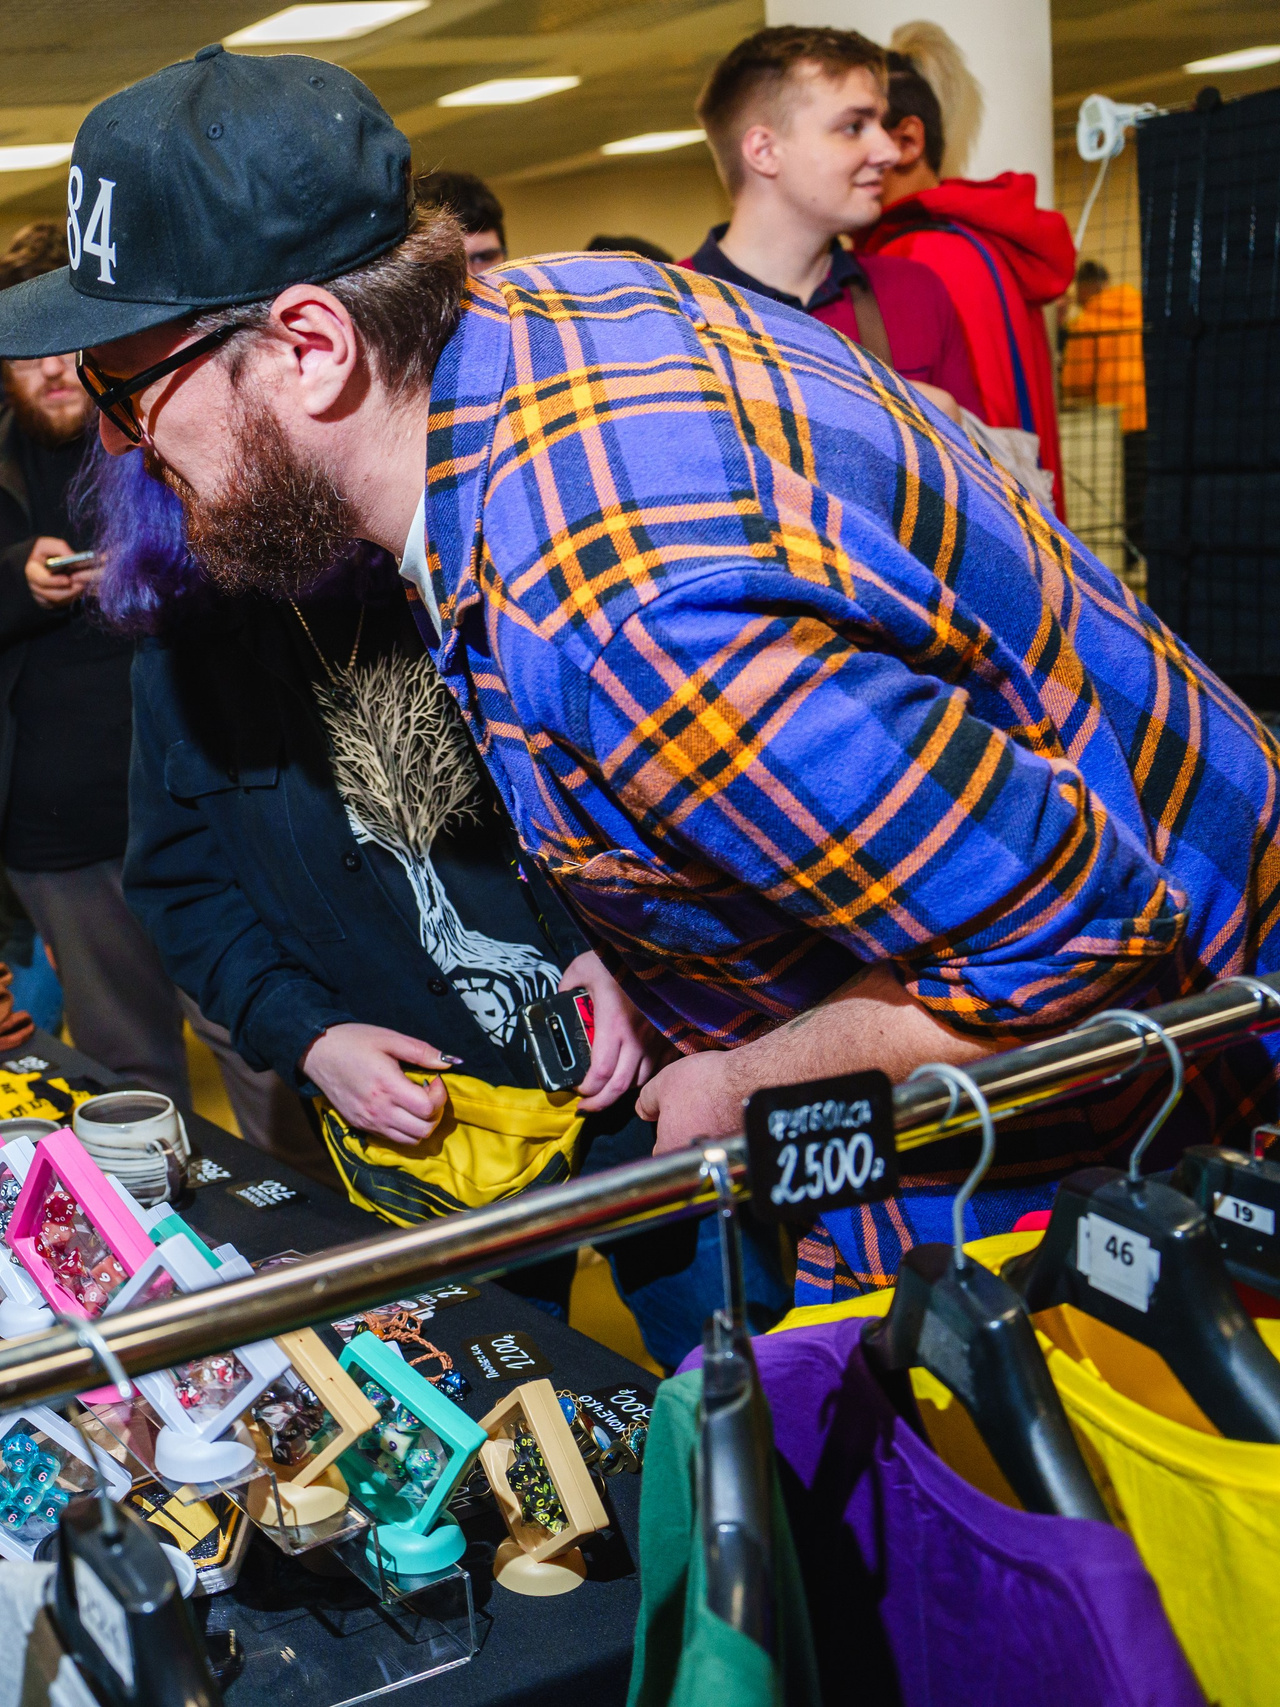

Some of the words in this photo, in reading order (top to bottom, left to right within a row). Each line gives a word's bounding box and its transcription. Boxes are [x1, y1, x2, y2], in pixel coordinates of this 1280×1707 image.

[67, 165, 117, 285] 84
[1232, 1202, 1254, 1223] 19
[1104, 1235, 1135, 1266] 46
